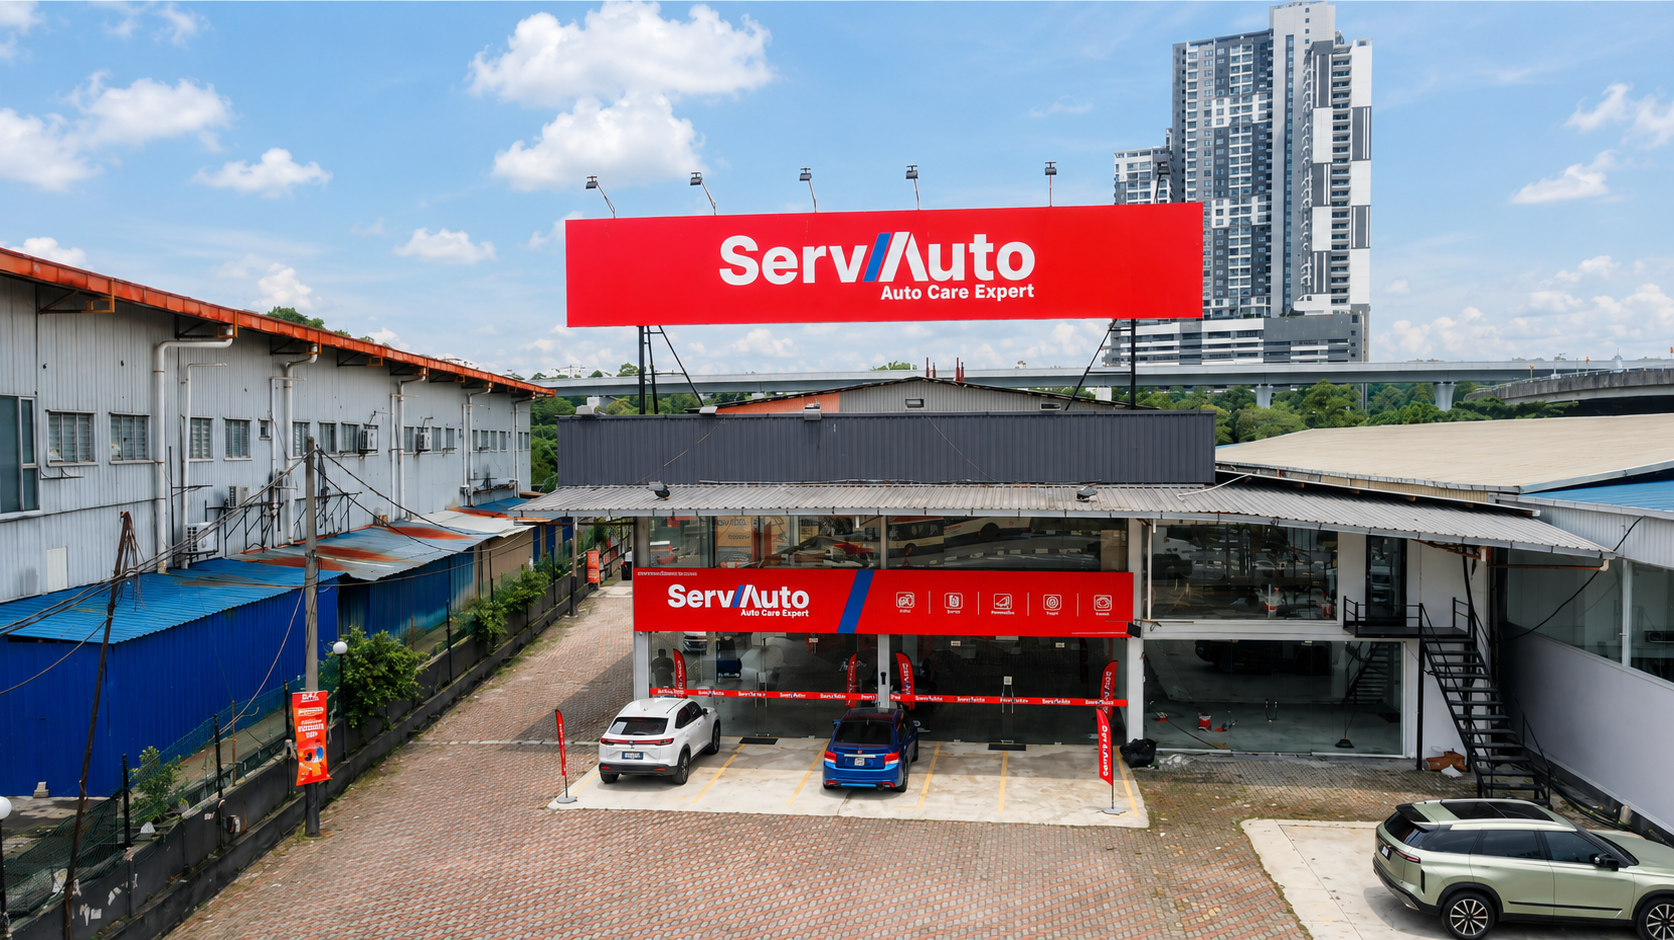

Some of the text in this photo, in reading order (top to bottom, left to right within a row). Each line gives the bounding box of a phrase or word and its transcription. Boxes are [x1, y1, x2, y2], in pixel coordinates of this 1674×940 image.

[880, 283, 1034, 302] Auto Care Expert
[740, 609, 809, 618] Auto Care Expert
